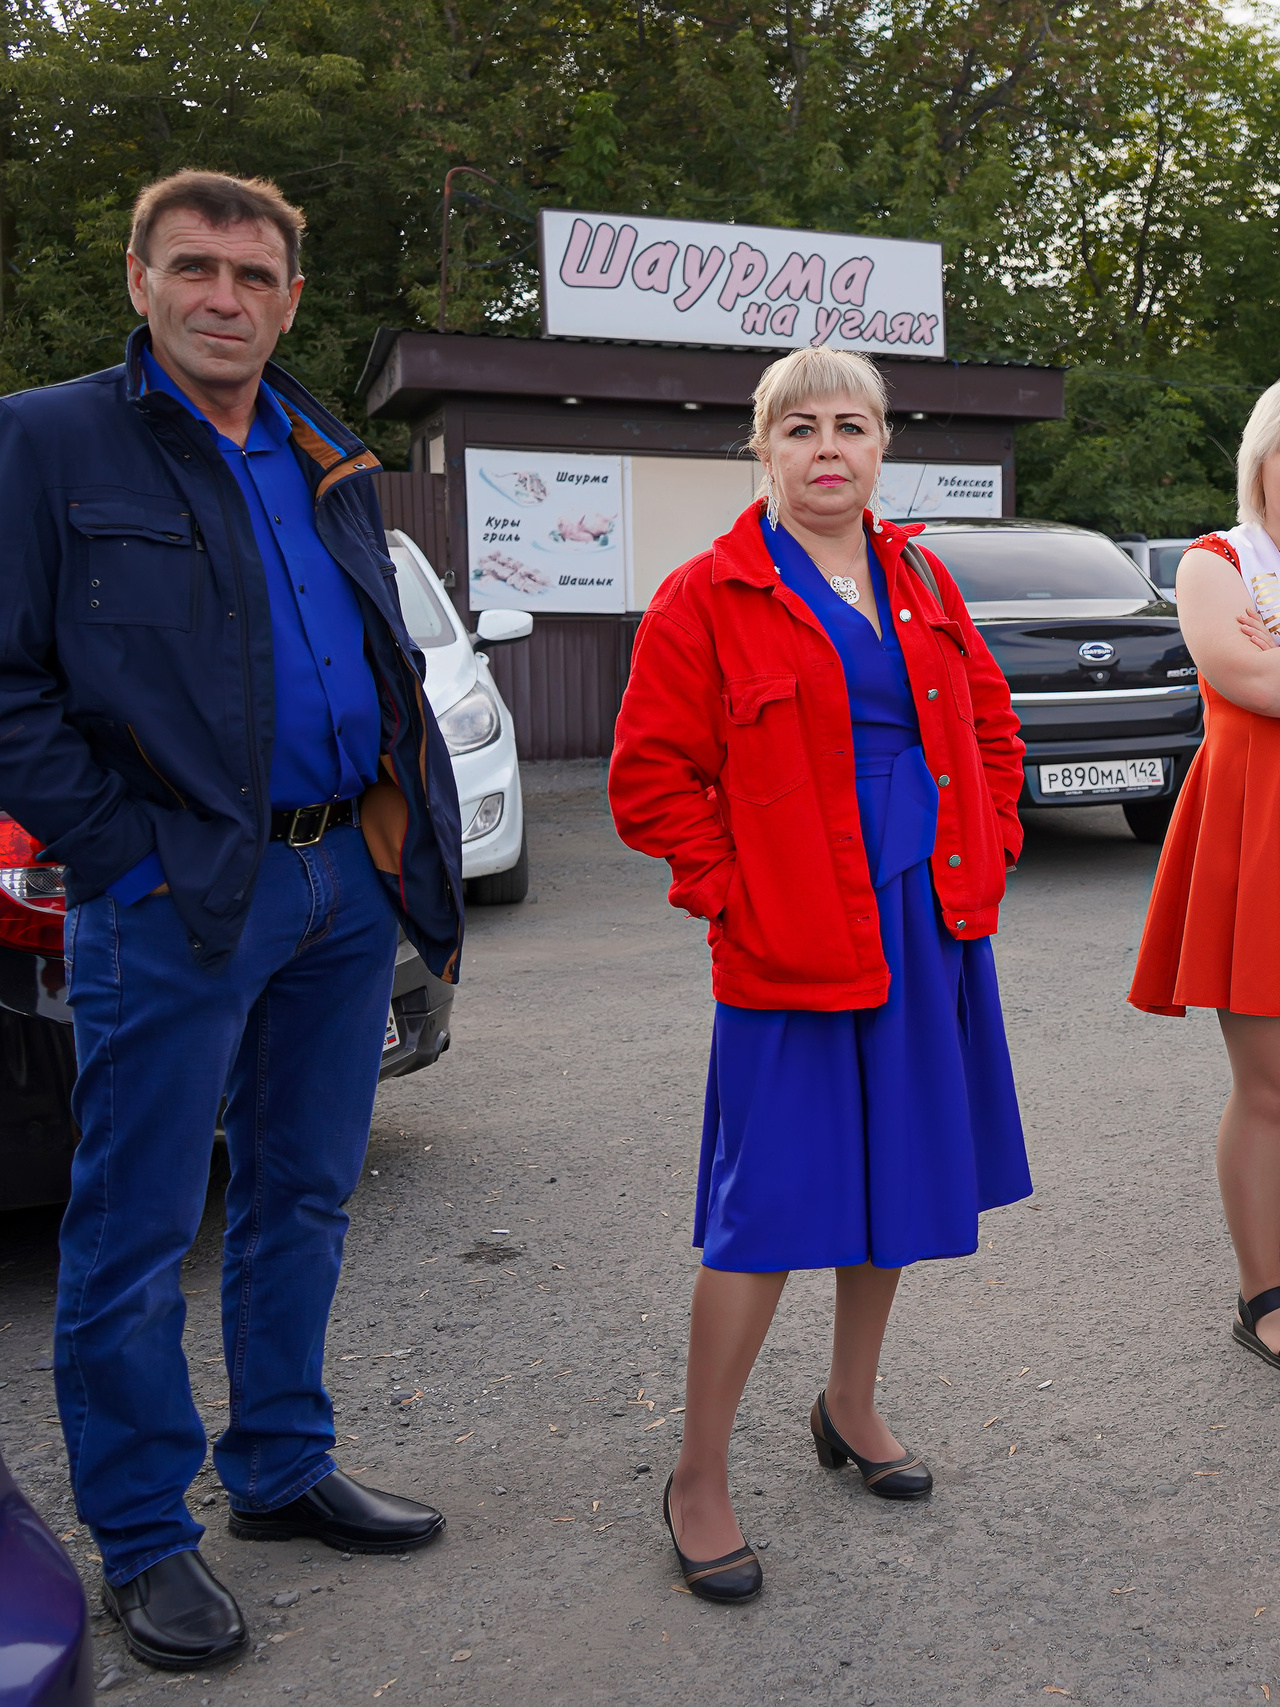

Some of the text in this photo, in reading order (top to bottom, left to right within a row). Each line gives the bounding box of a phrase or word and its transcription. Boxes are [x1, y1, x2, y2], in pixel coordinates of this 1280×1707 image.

[559, 218, 875, 312] Шаурма
[741, 302, 939, 347] на углях
[556, 471, 609, 486] Шаурма
[938, 475, 994, 488] Узбекская
[947, 489, 994, 499] лепешка
[485, 516, 521, 530] Куры
[483, 532, 521, 543] гриль
[558, 575, 613, 588] Шашлык
[1129, 762, 1157, 777] 142
